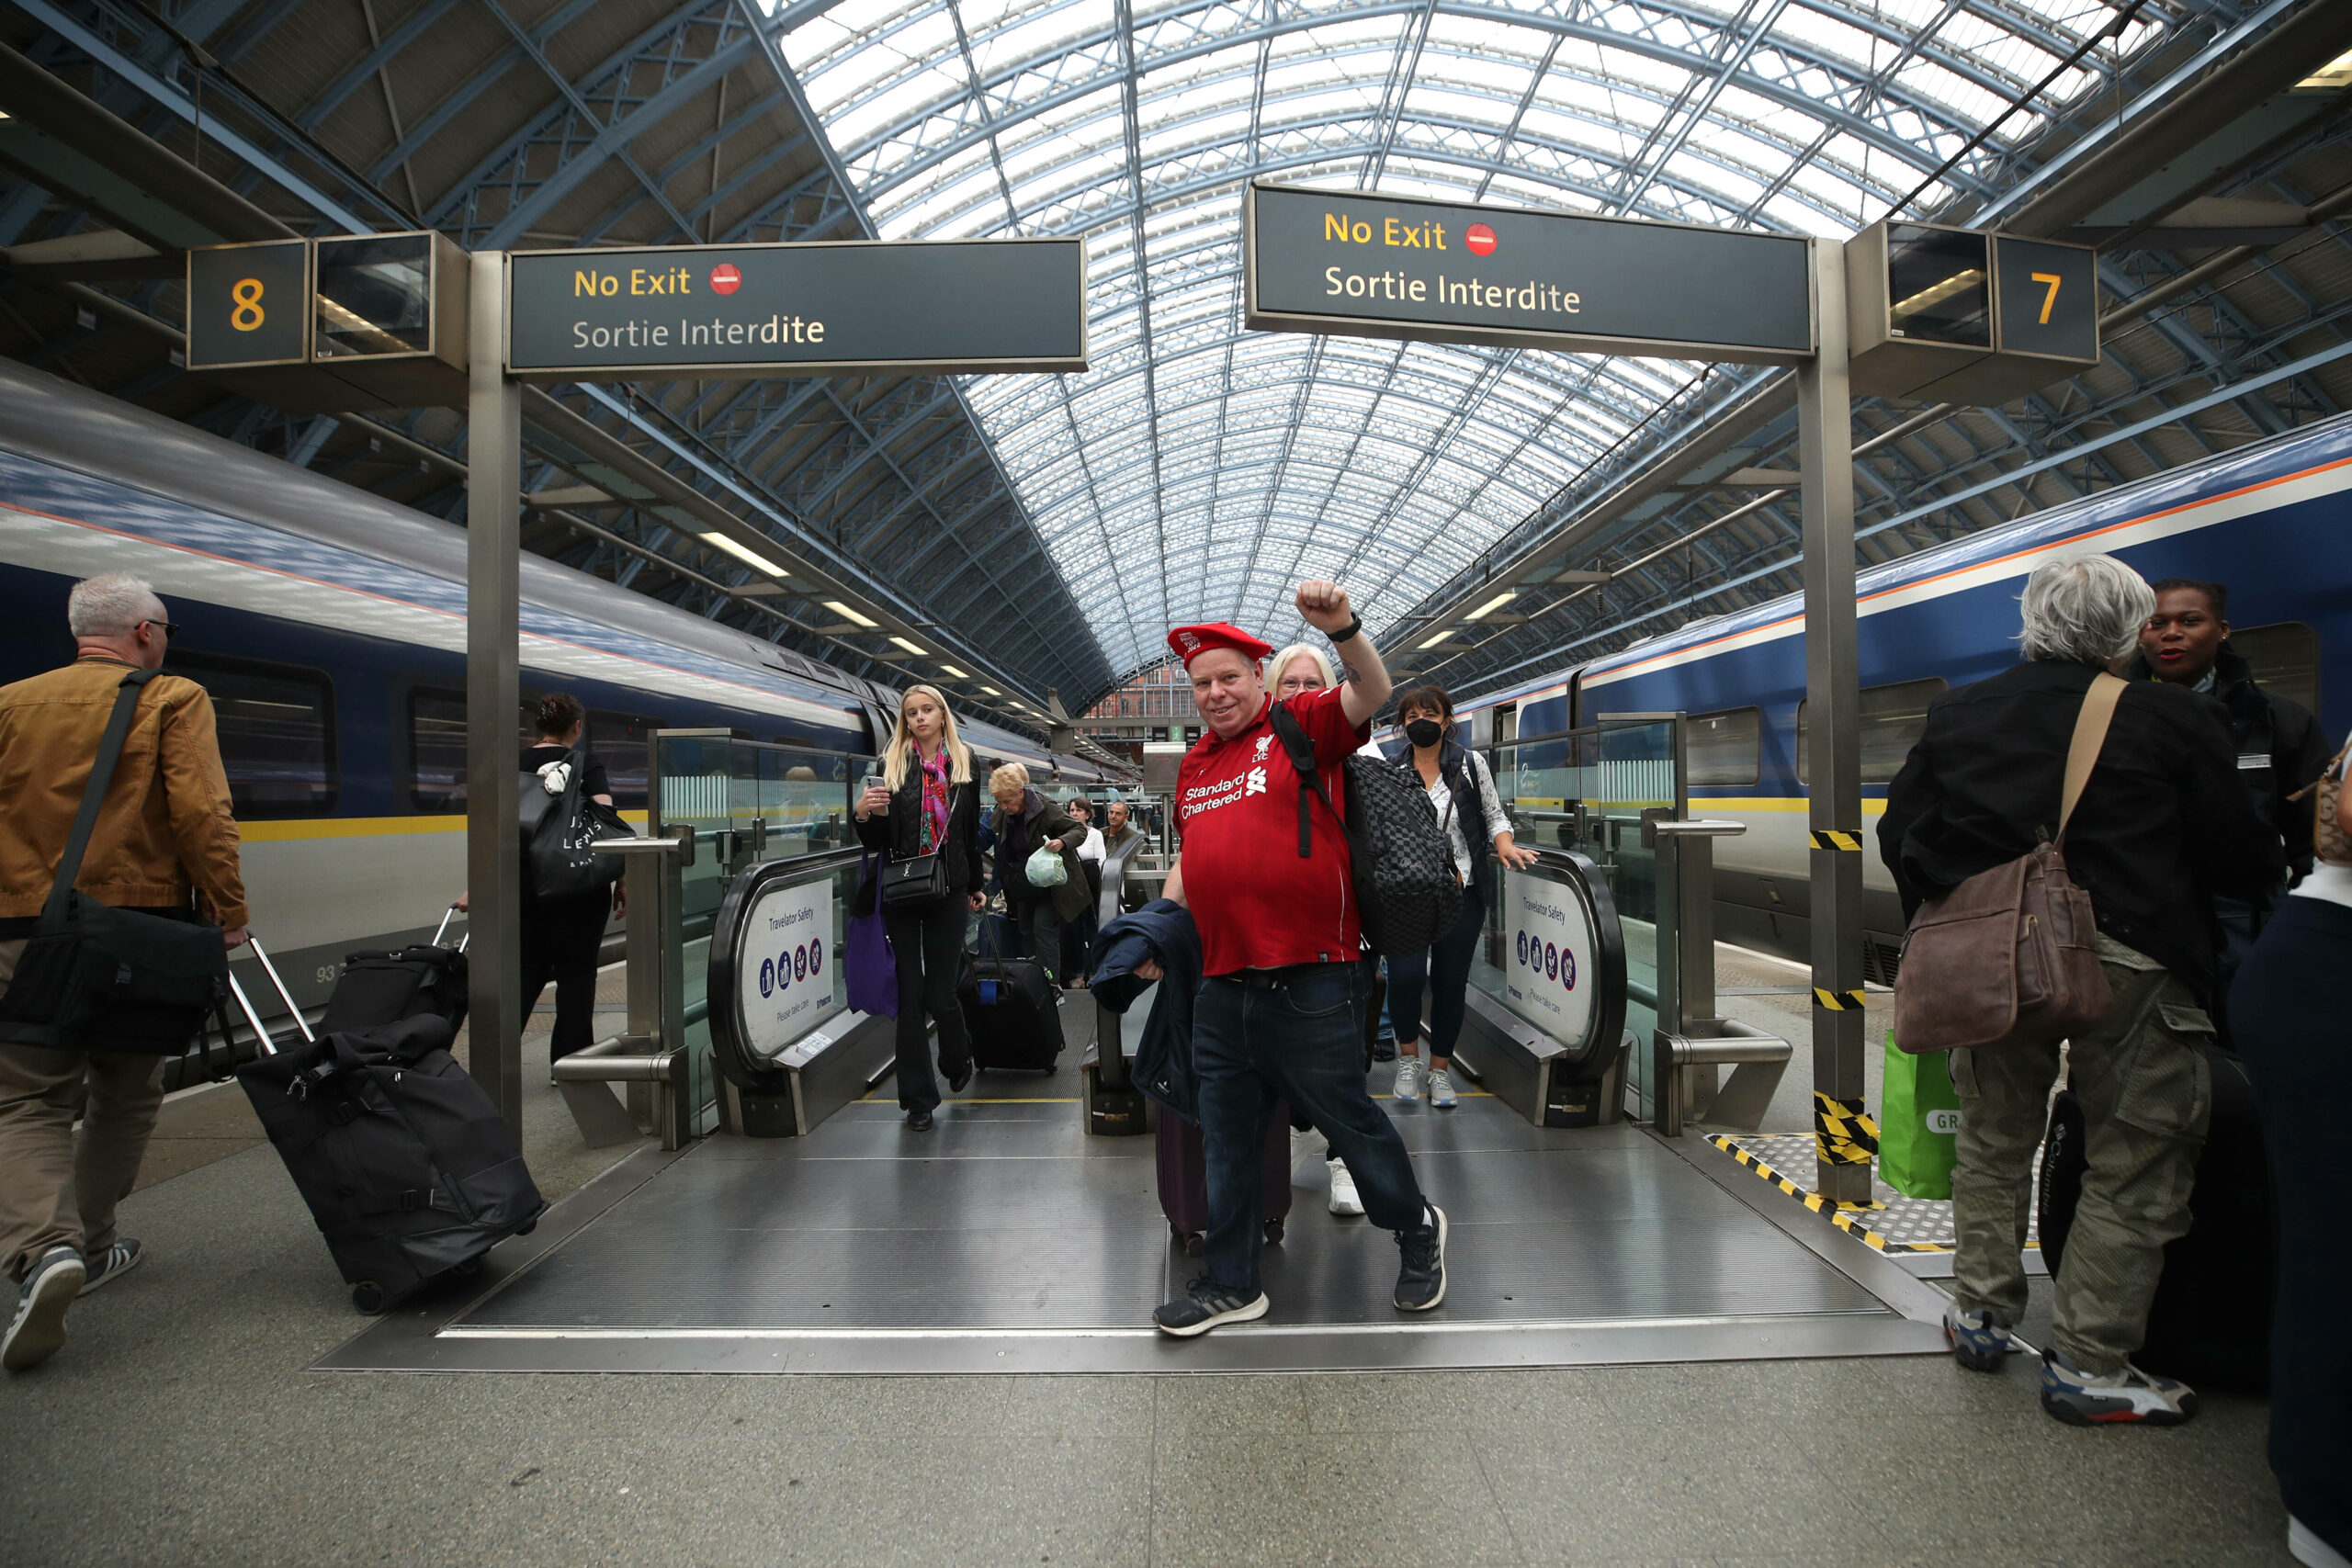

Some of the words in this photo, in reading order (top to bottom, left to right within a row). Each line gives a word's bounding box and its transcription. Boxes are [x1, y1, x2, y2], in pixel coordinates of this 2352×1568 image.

[1324, 212, 1373, 243] No
[1385, 217, 1447, 250] Exit
[574, 270, 619, 297] No
[630, 266, 691, 295] Exit
[1325, 265, 1427, 302] Sortie
[1439, 275, 1580, 314] Interdite
[2031, 271, 2062, 324] 7
[231, 277, 265, 331] 8
[572, 318, 669, 348] Sortie
[681, 314, 825, 345] Interdite
[1251, 754, 1269, 763] LFC
[1185, 771, 1246, 802] Standard
[1181, 786, 1243, 820] Chartered
[768, 912, 797, 931] Travelator
[797, 907, 814, 921] Safety
[1522, 897, 1548, 917] Travelator
[1548, 904, 1566, 926] Safety
[316, 965, 335, 983] 93
[776, 1010, 791, 1022] Please
[791, 1002, 800, 1015] take
[800, 998, 809, 1010] care
[2041, 1141, 2063, 1215] Columbia
